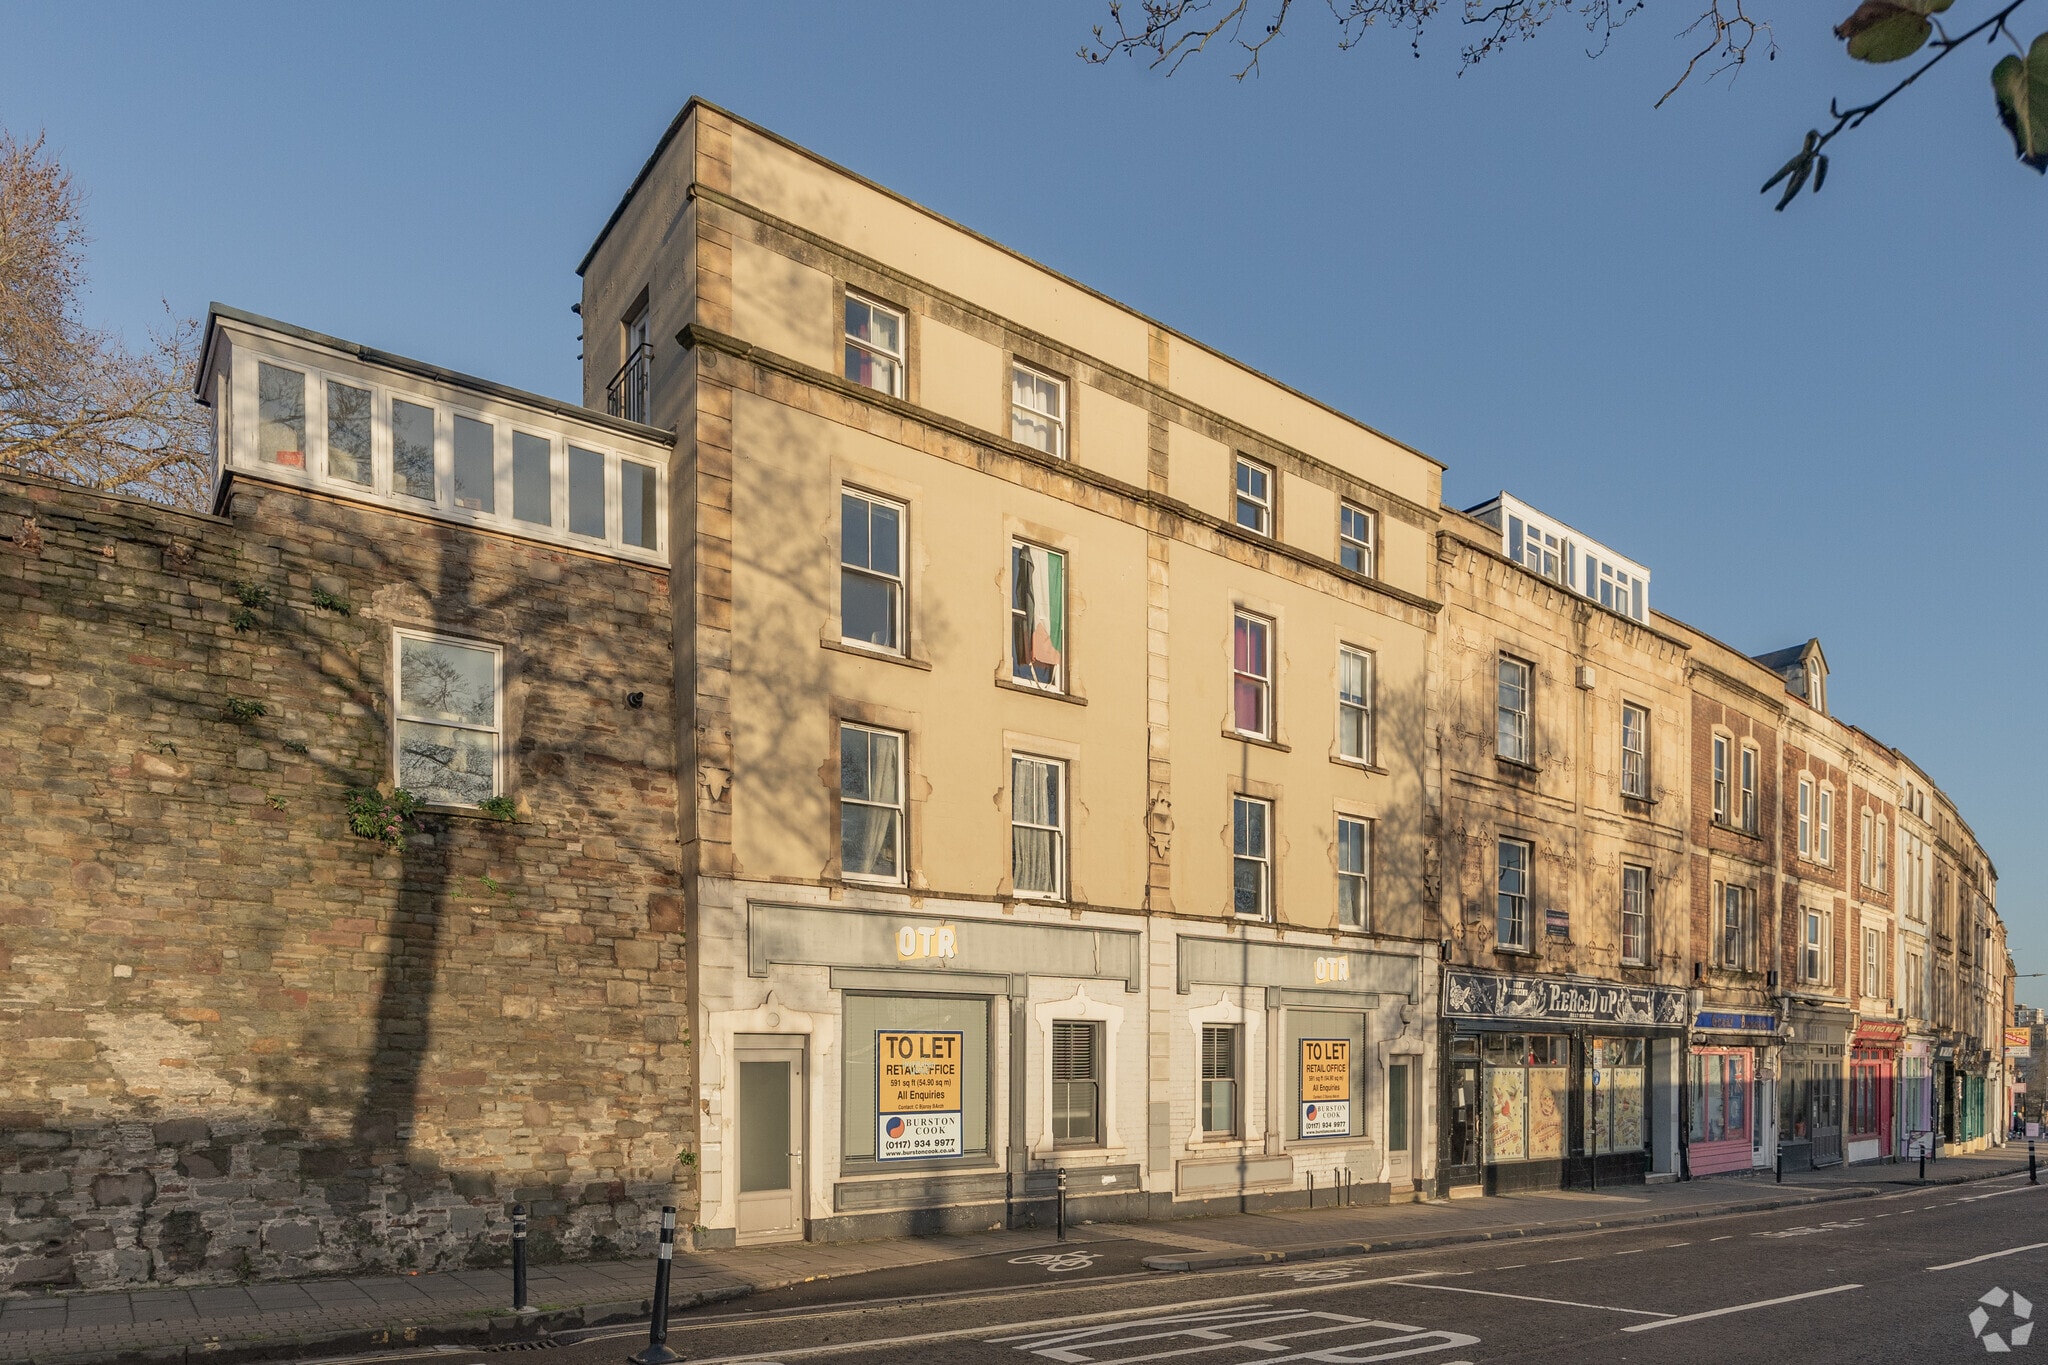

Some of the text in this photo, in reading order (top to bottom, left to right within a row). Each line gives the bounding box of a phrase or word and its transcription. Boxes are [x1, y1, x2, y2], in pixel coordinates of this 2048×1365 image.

[900, 926, 955, 958] OTR
[1316, 957, 1348, 981] OTR
[1548, 984, 1617, 1013] PIERCED UP
[886, 1036, 955, 1059] TO LET
[1307, 1043, 1346, 1060] TO LET
[902, 1080, 910, 1088] sq
[917, 1079, 934, 1087] (54.90
[944, 1079, 951, 1087] m)
[1320, 1084, 1340, 1092] Enquiries
[897, 1090, 945, 1101] All Enquiries
[906, 1117, 955, 1126] BURSTON
[916, 1127, 945, 1135] COOK
[886, 1140, 910, 1150] (0117)
[914, 1140, 930, 1148] 934
[886, 1148, 955, 1156] www.burstoncook.co.uk
[983, 1304, 1482, 1365] KEEP
